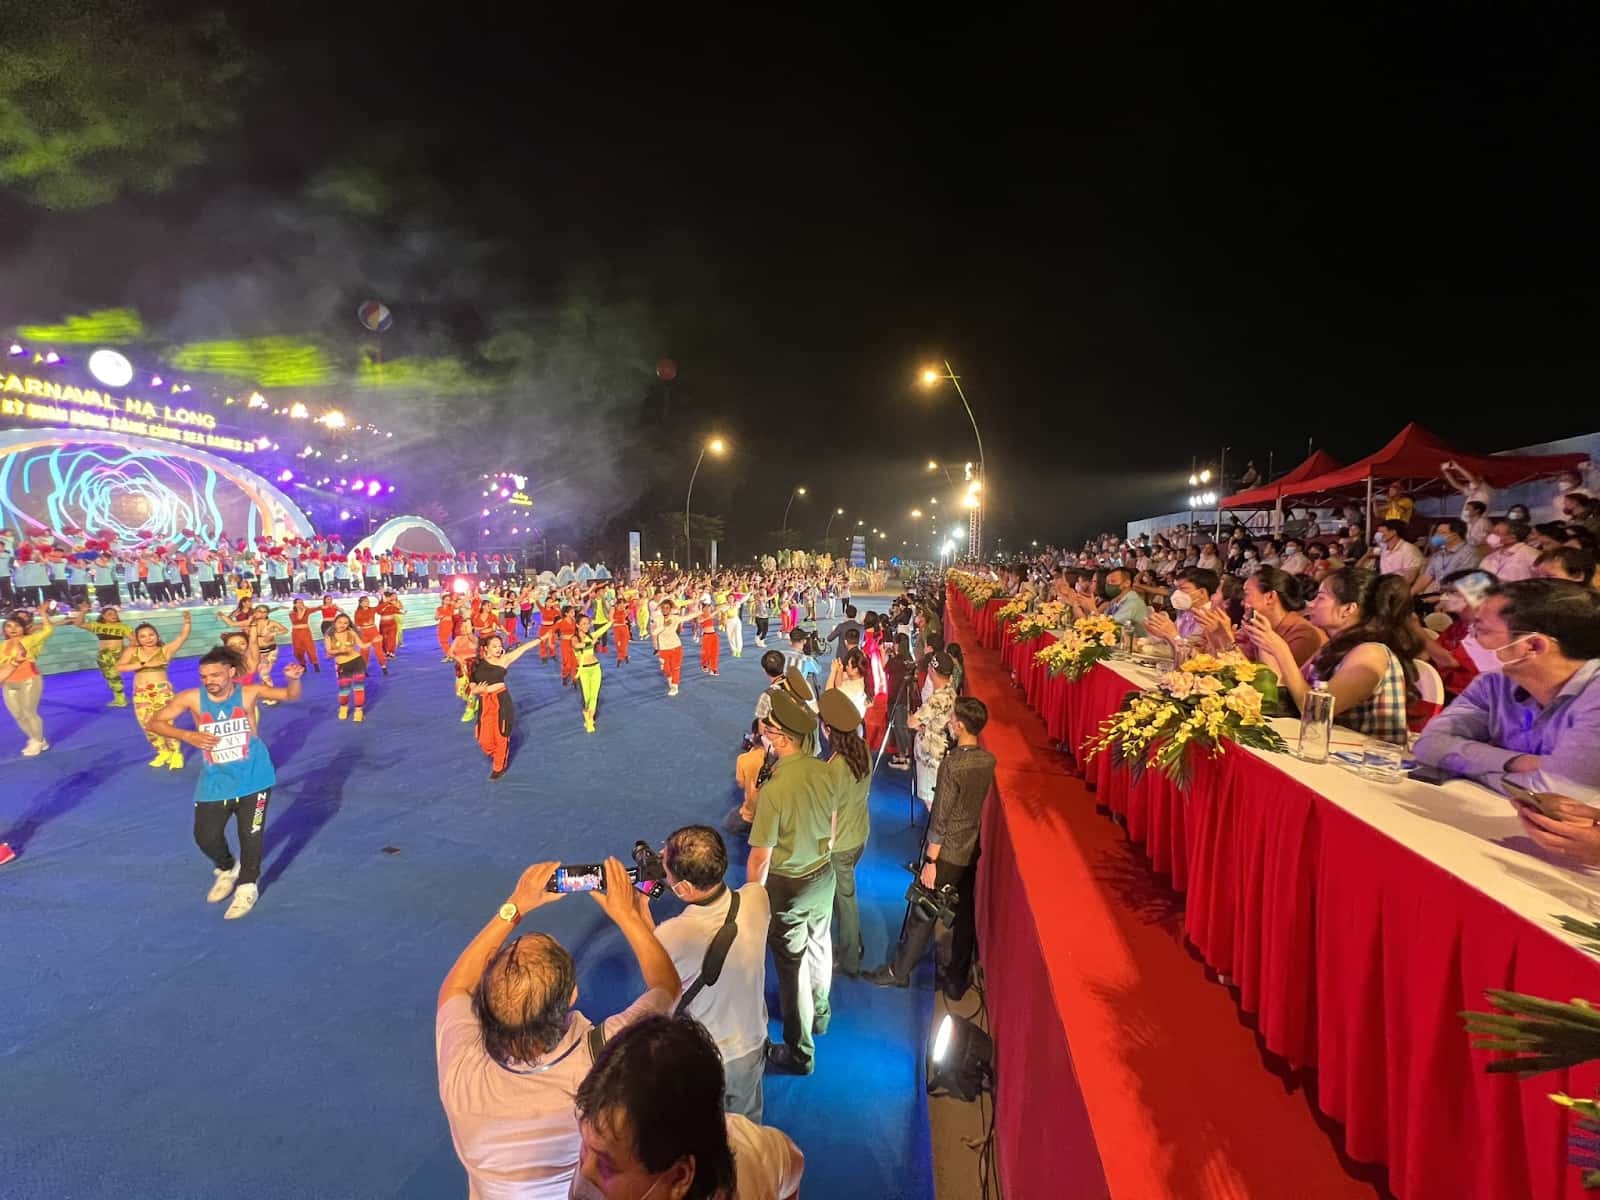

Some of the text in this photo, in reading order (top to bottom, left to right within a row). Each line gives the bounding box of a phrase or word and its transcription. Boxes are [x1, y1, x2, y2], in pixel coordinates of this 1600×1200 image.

[0, 373, 120, 409] ARNAVAL
[164, 405, 217, 429] LONG
[217, 710, 227, 720] A
